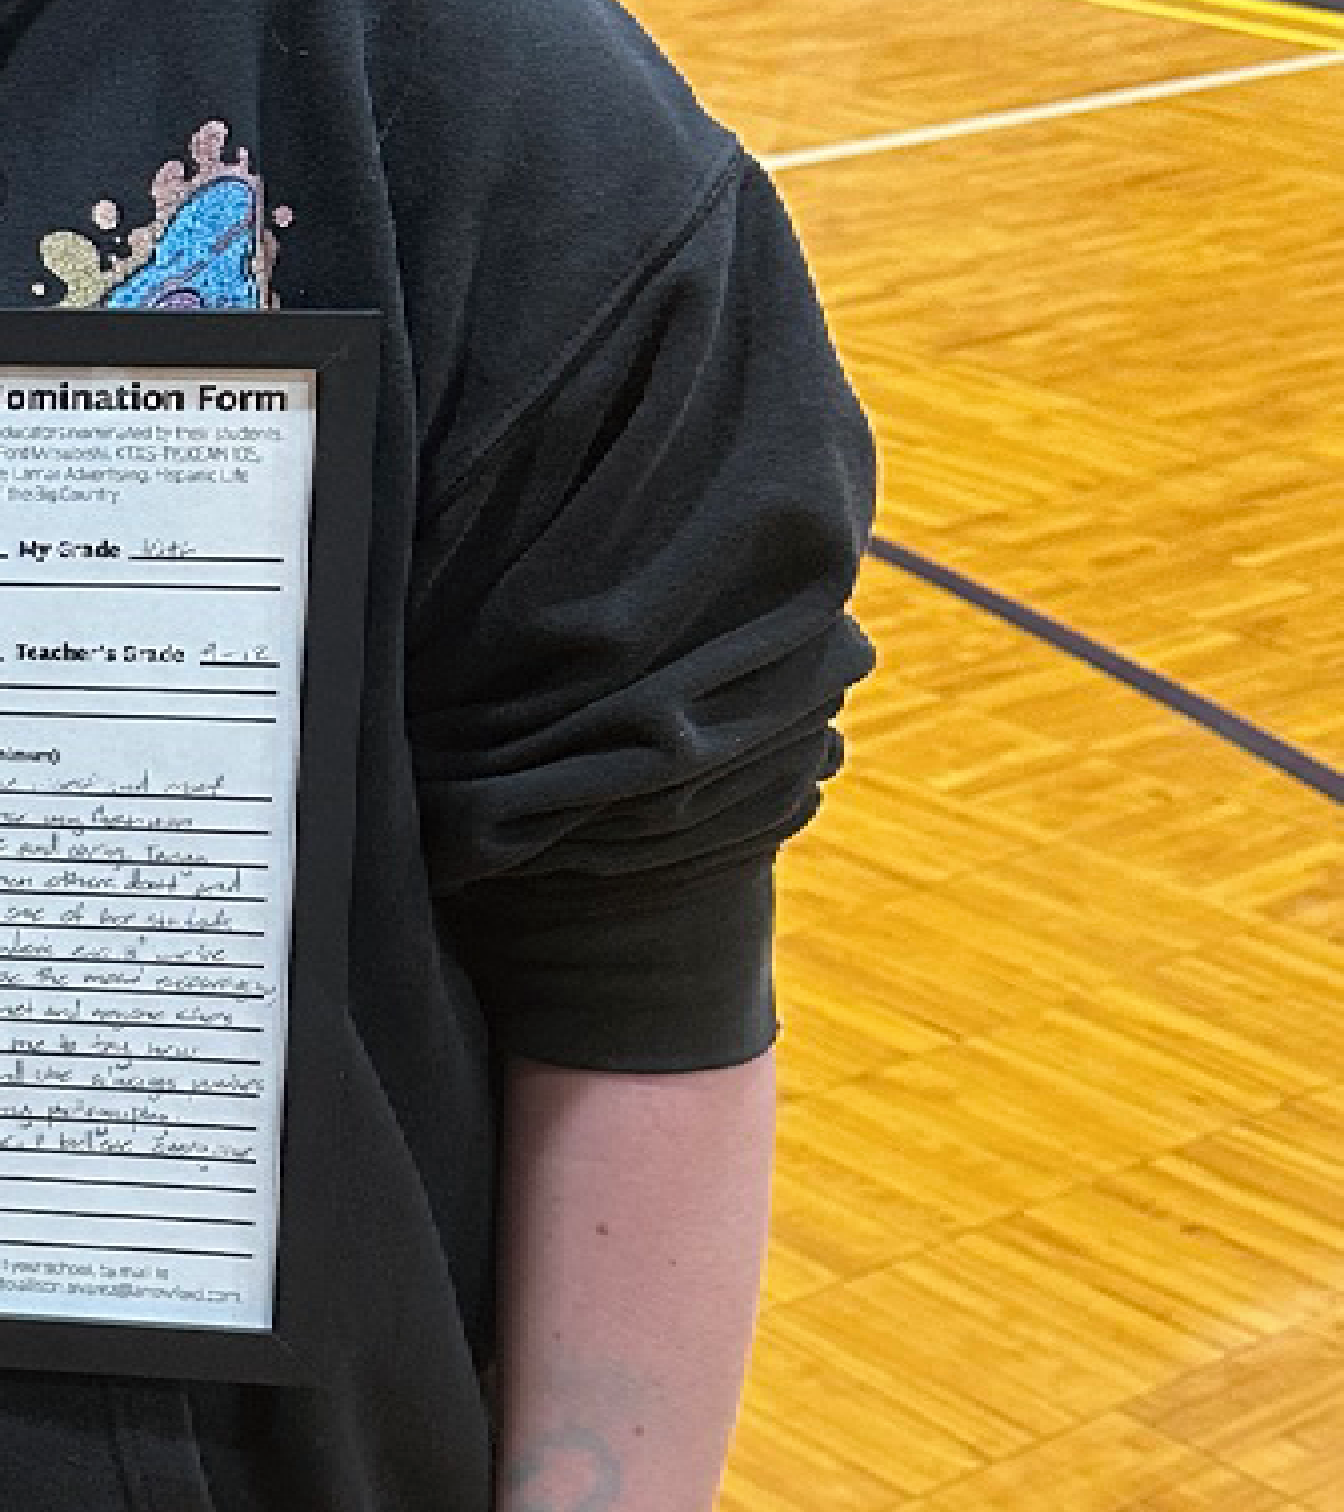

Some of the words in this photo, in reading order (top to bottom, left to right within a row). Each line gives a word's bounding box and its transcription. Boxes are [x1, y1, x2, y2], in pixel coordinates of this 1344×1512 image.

[197, 384, 288, 413] Form
[18, 538, 52, 564] My
[56, 538, 121, 560] Grade
[15, 641, 117, 664] Teacher's
[122, 642, 187, 665] Grade
